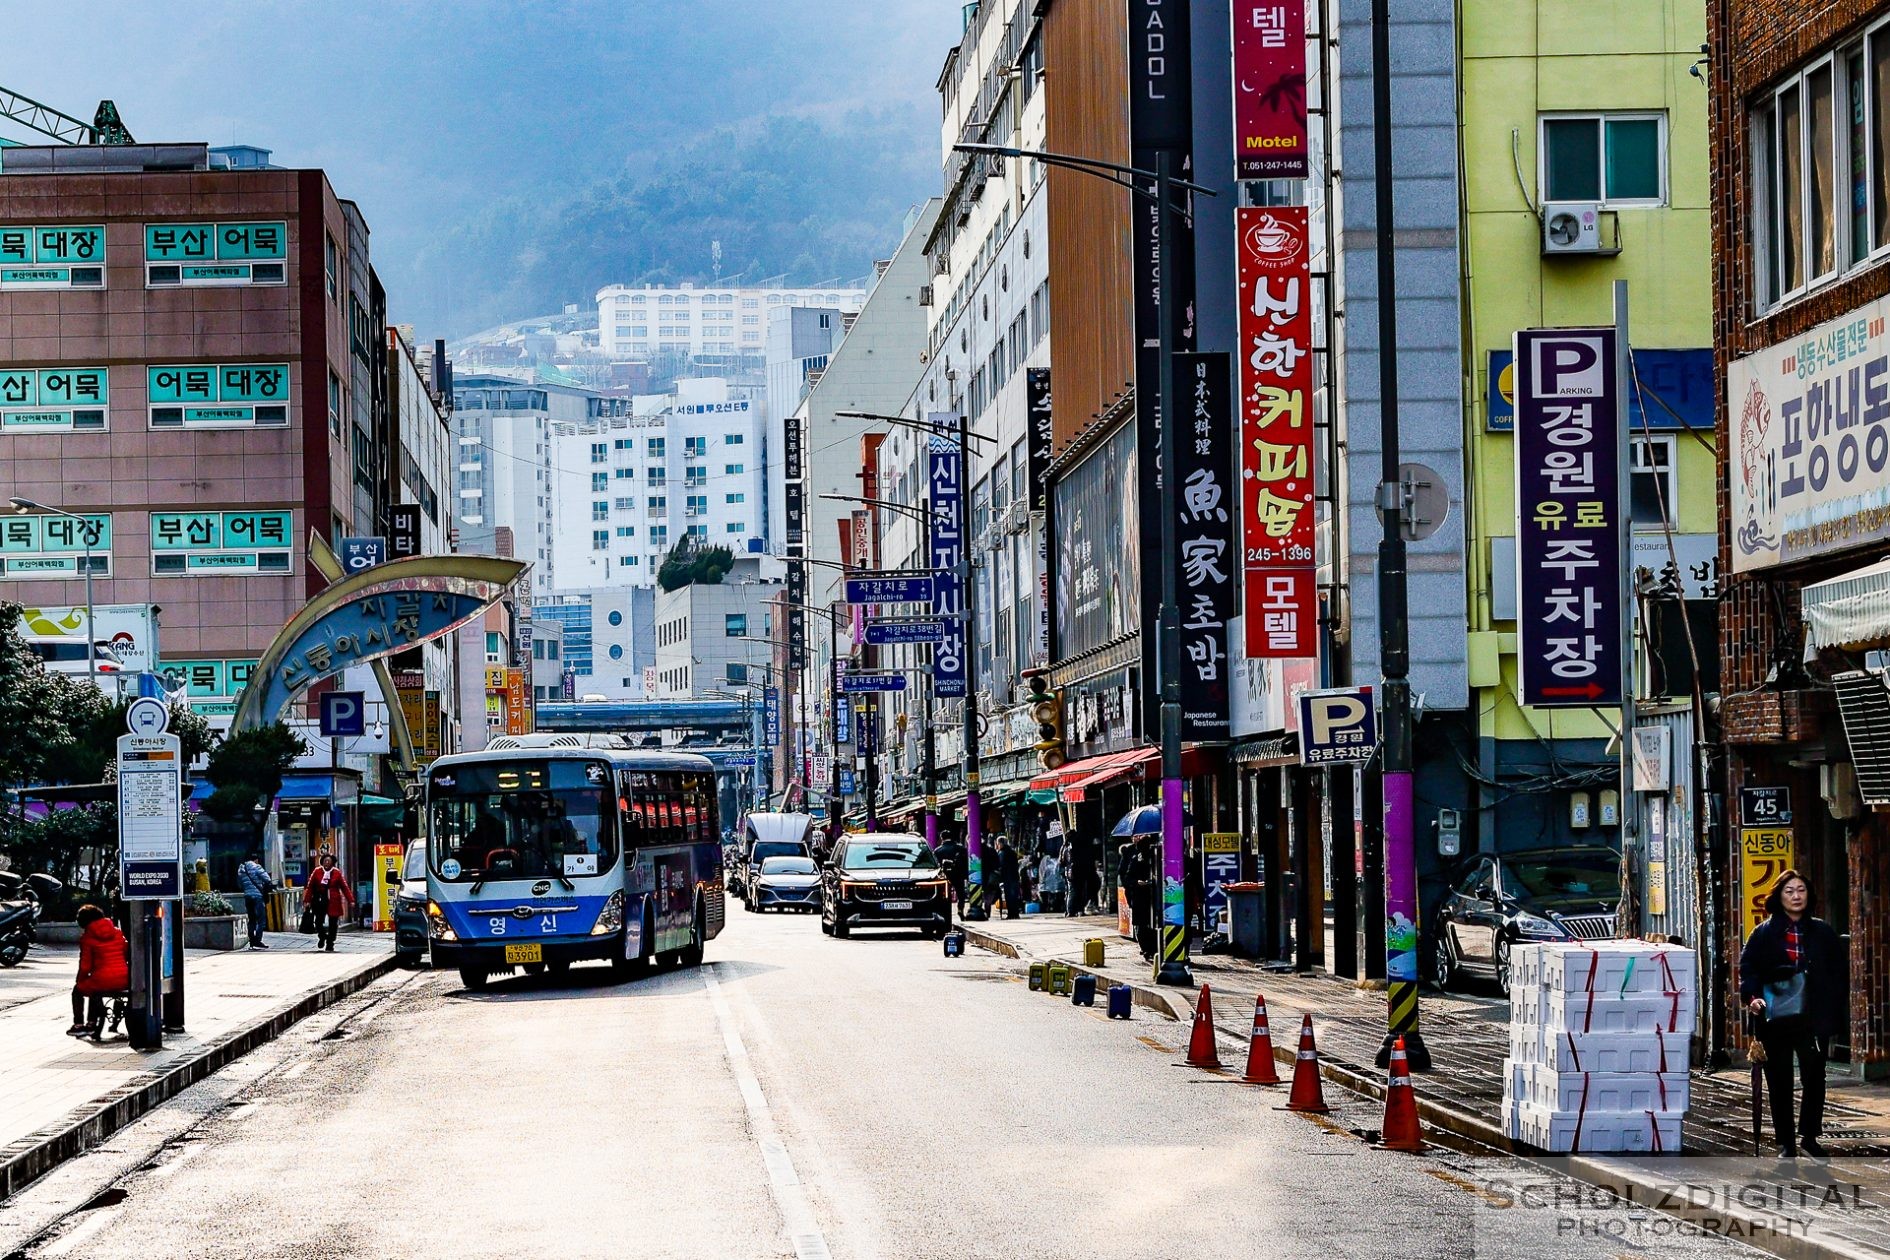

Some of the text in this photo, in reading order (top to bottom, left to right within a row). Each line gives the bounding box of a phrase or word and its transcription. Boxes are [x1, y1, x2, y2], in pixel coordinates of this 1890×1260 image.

[1250, 6, 1283, 47] 텔
[1146, 0, 1165, 98] ADOL
[1244, 134, 1294, 146] Motel
[43, 231, 98, 259] 대장
[152, 228, 279, 256] 부산 어묵
[1254, 257, 1296, 269] COFFEE SHOP
[1797, 318, 1867, 380] 냉동수산물전문
[46, 374, 100, 400] 어묵
[156, 370, 282, 398] 어묵 대장
[1194, 361, 1211, 457] 日本式料理
[1539, 403, 1595, 493] 경원
[1533, 501, 1607, 531] 유료
[48, 520, 104, 546] 대장
[159, 517, 285, 545] 부산 어묵
[349, 544, 379, 555] 부산
[1247, 547, 1312, 562] 245-1396
[858, 581, 909, 595] 자갈치로
[864, 593, 904, 602] Jagalchi-ro
[361, 593, 457, 619] 자갈치
[1262, 576, 1299, 650] 모텔
[1539, 540, 1602, 678] 주차장
[282, 615, 420, 691] 신동아시장
[330, 698, 356, 732] P
[1184, 711, 1217, 720] Japanese
[1310, 697, 1367, 745] P
[130, 738, 166, 746] 신동아시장
[1754, 798, 1777, 815] 45
[1744, 833, 1791, 855] 신동아
[533, 884, 550, 893] CNG
